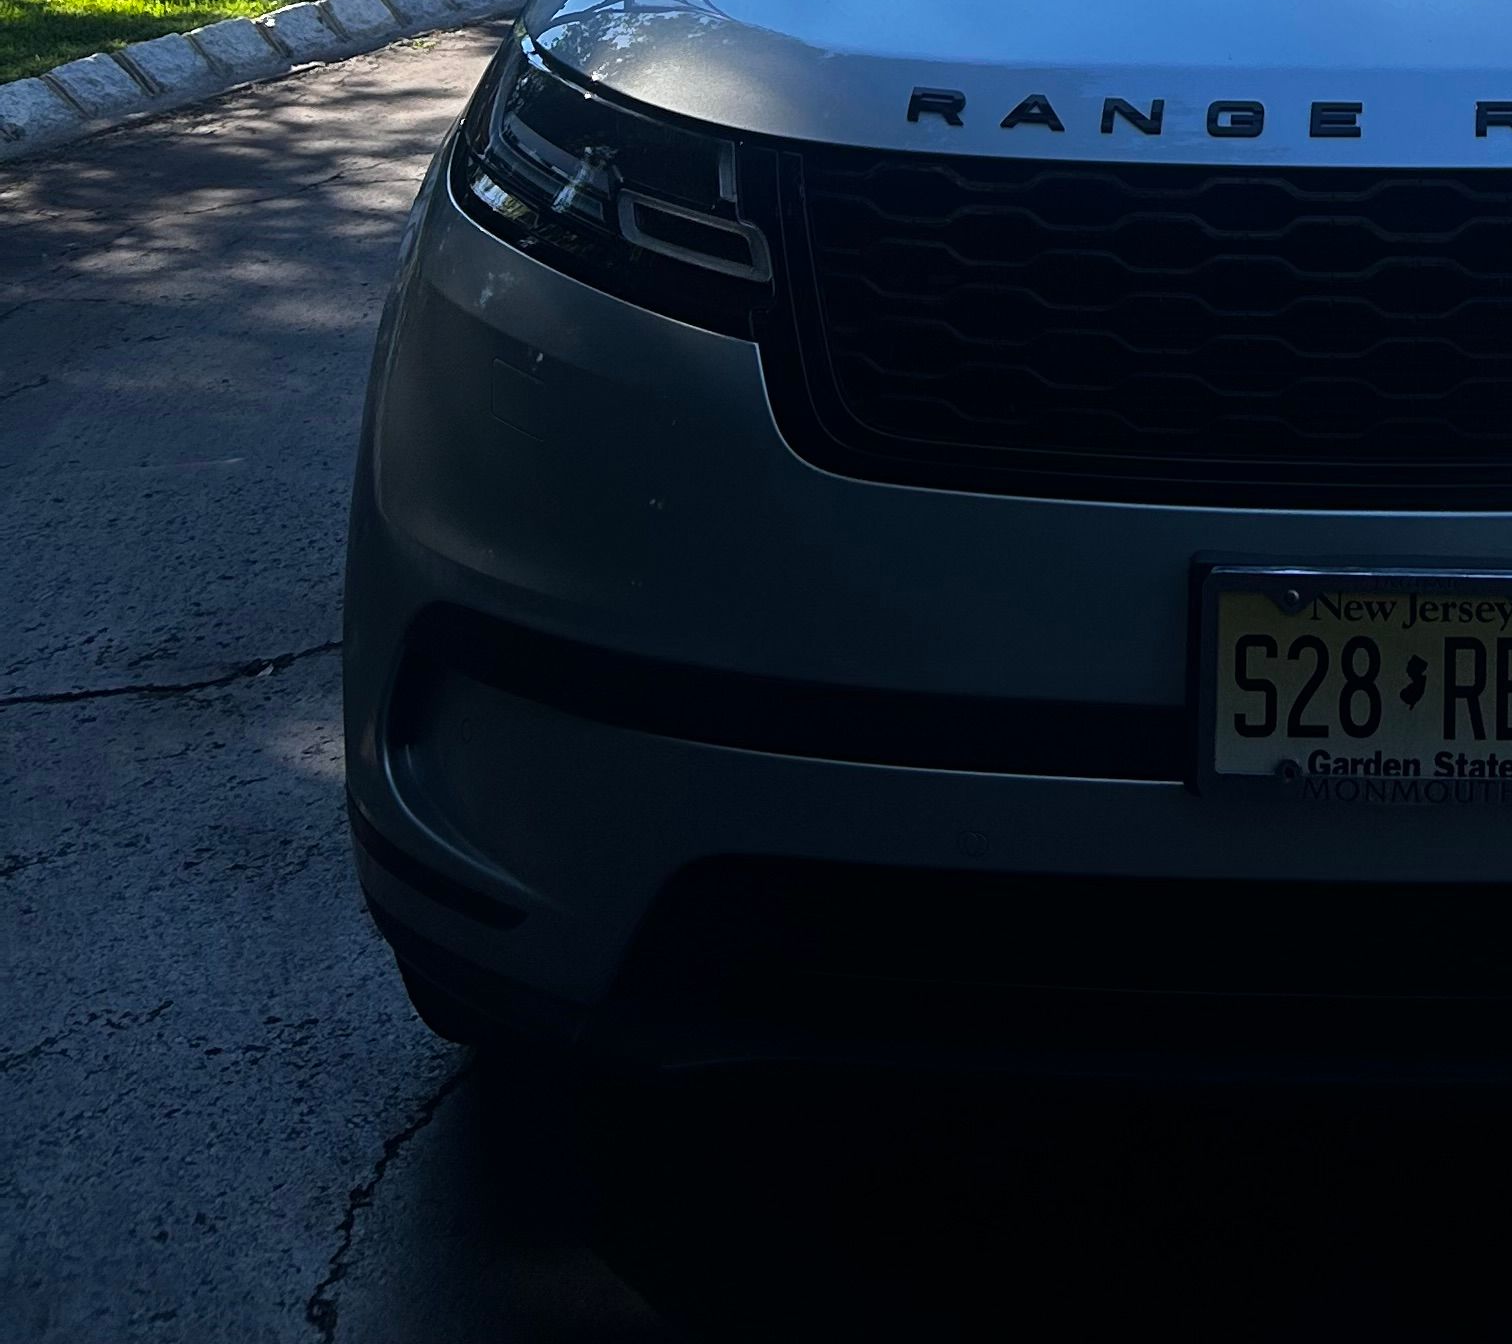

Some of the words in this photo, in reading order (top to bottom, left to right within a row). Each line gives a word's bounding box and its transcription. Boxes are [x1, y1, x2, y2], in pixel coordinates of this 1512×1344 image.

[906, 85, 1364, 140] RANGE
[1310, 592, 1396, 624] New
[1233, 633, 1382, 739] S28
[1307, 749, 1422, 777] Garden
